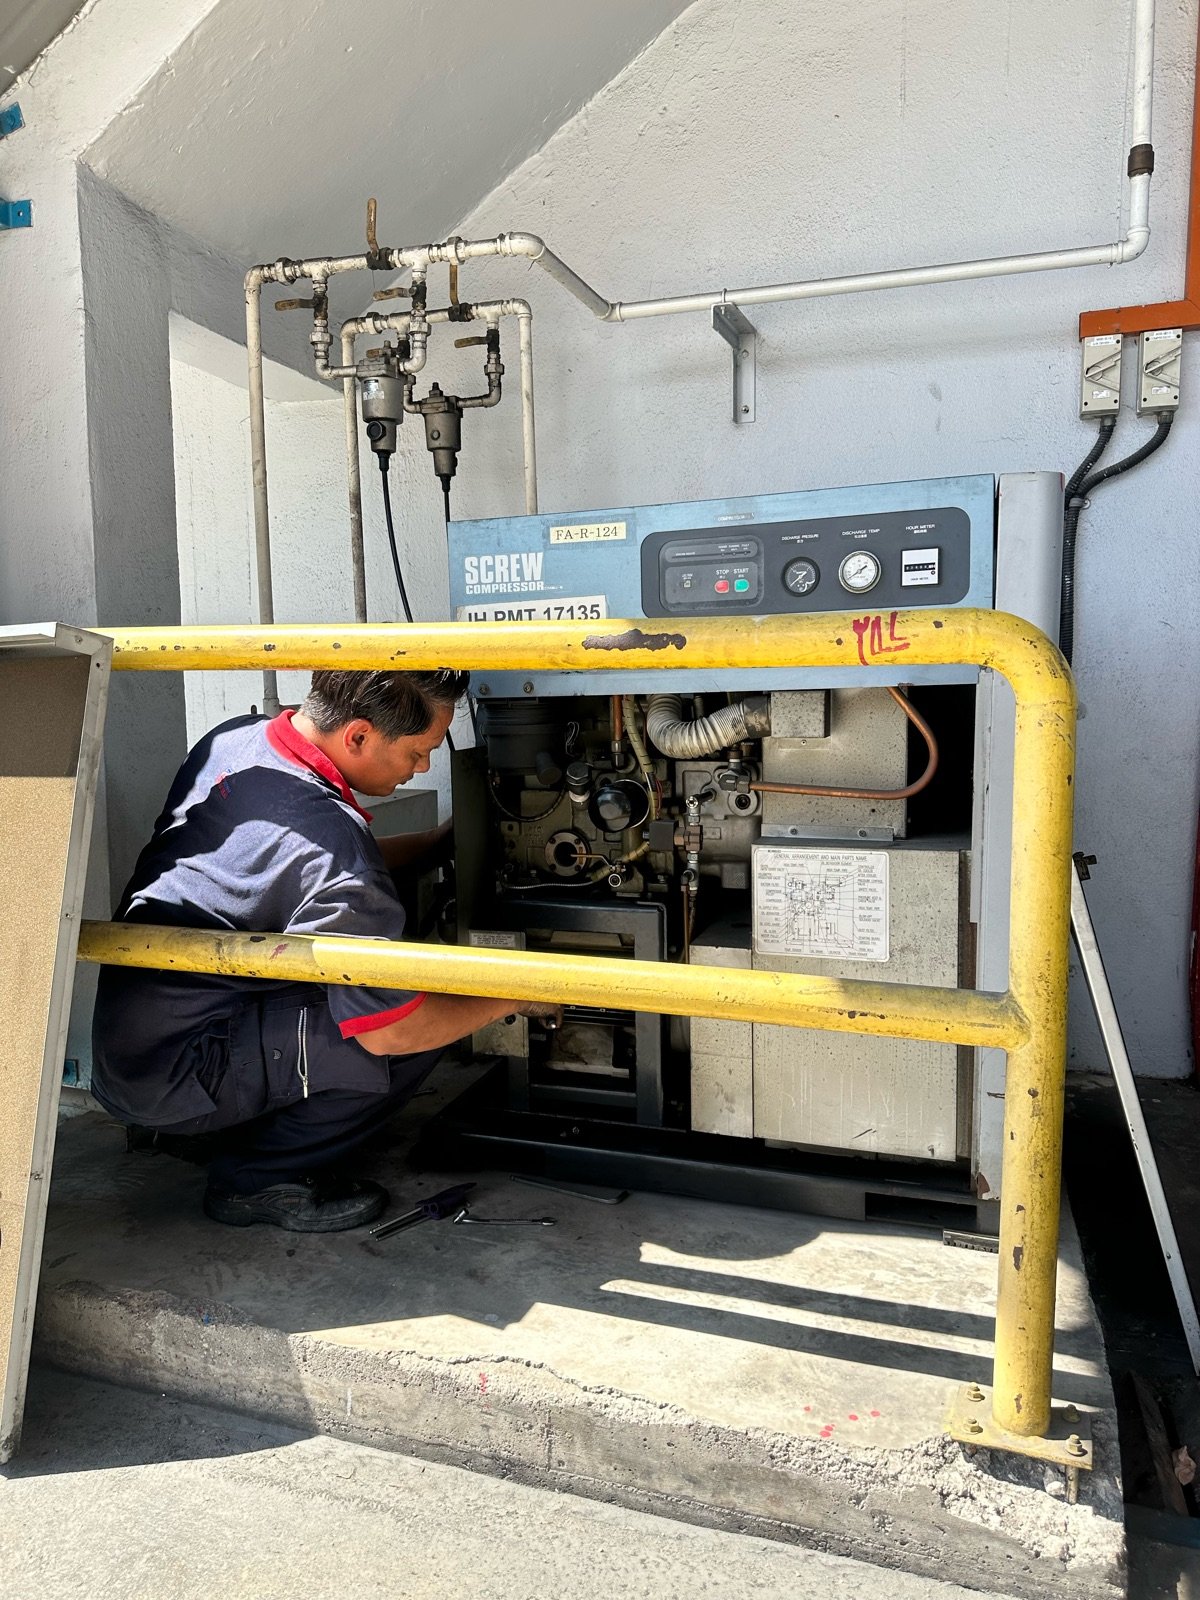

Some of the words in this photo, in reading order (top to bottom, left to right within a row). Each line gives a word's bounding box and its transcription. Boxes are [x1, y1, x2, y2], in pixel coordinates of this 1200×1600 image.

[555, 526, 618, 541] FA-R-124
[464, 552, 544, 585] SCREW
[465, 580, 545, 595] COMPRESSOR
[543, 603, 601, 621] 17135
